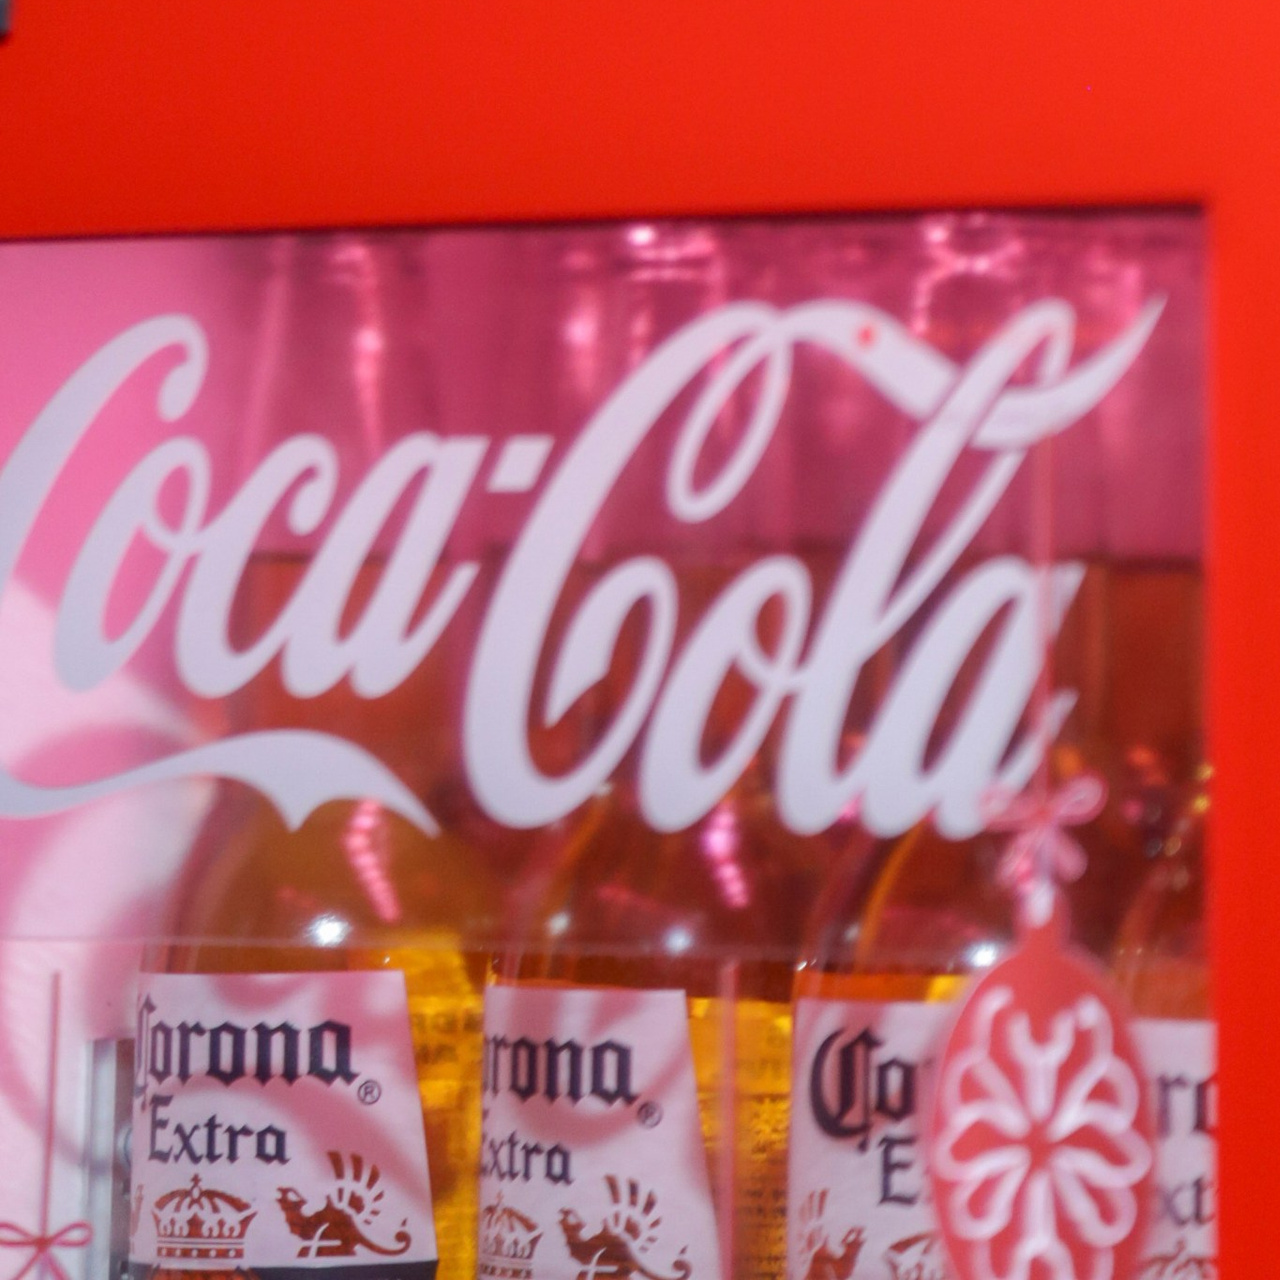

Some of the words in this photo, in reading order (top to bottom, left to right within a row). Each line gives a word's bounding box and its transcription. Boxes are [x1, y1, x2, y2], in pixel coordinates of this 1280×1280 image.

[0, 293, 1167, 839] Coca-Cola
[482, 1034, 640, 1107] rona
[148, 1092, 292, 1165] Extra
[481, 1130, 575, 1186] xtra
